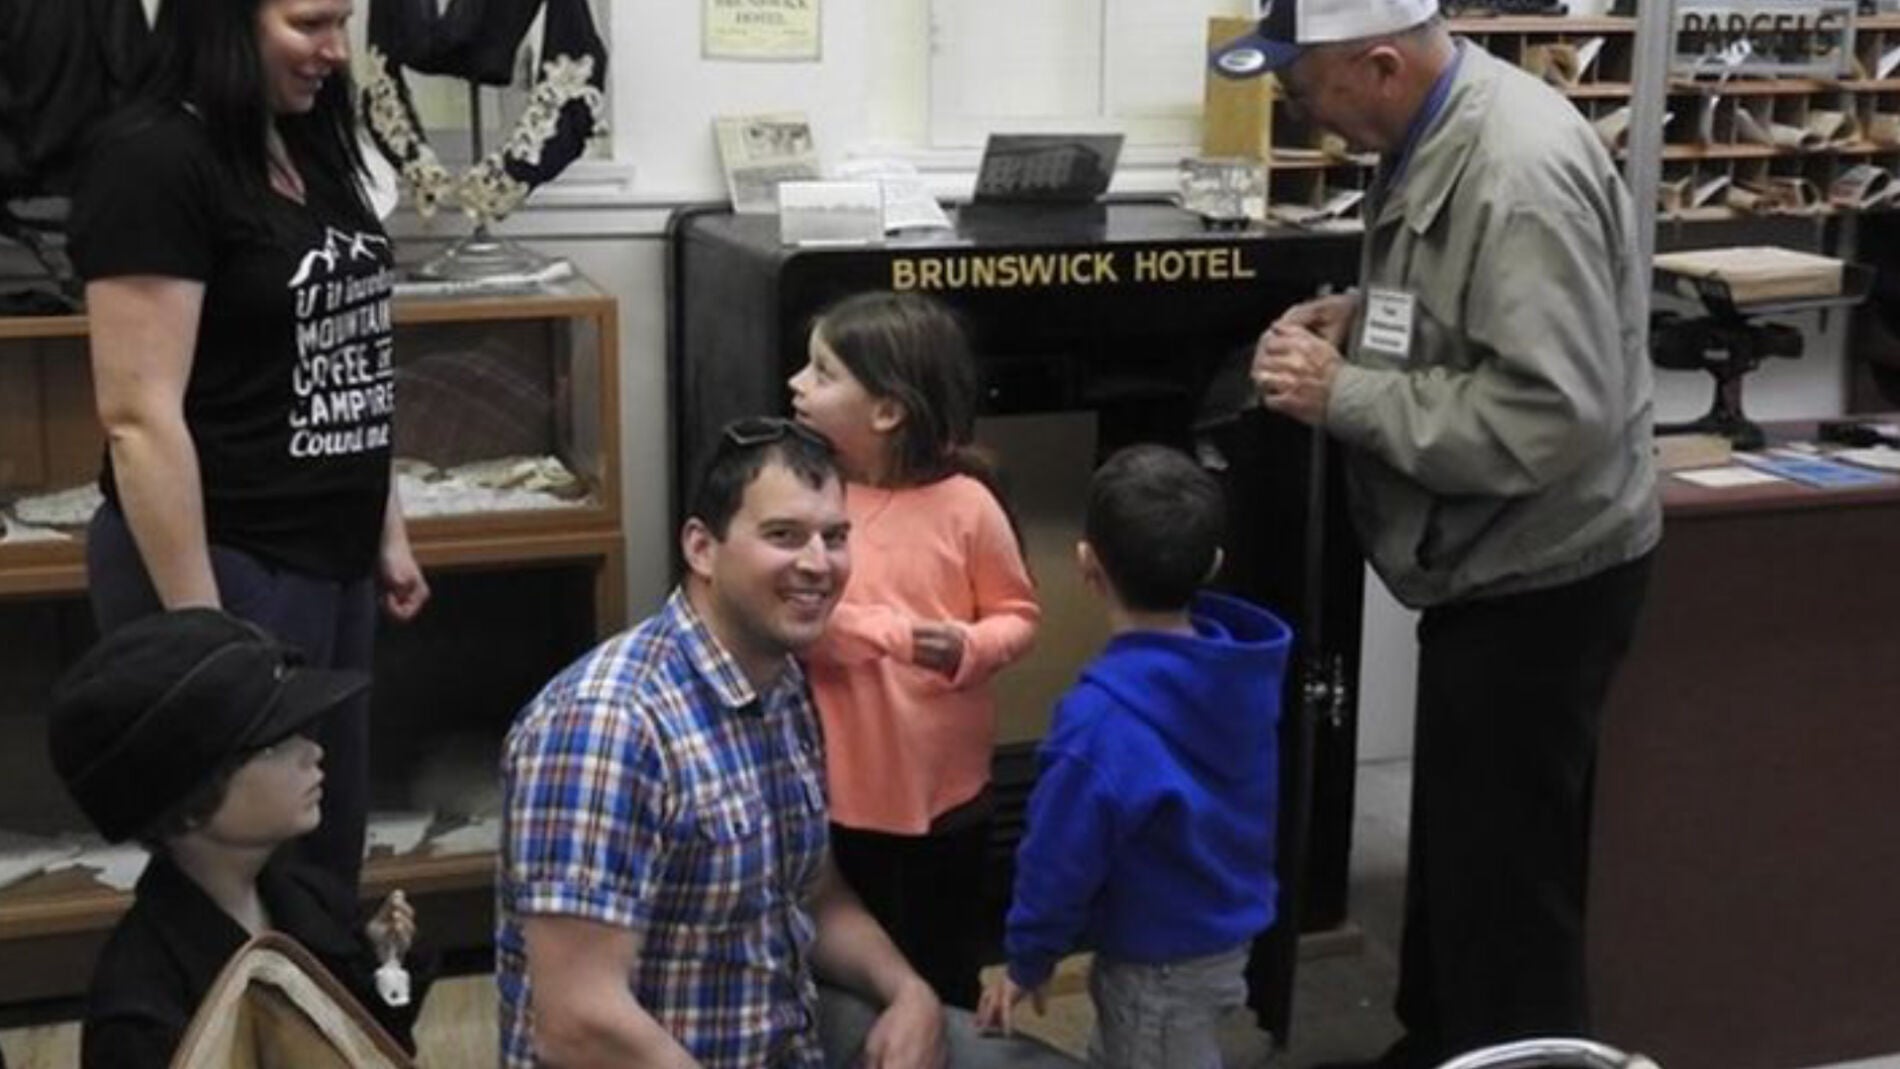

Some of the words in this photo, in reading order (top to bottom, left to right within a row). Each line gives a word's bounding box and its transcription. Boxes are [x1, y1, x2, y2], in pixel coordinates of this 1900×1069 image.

[1683, 13, 1838, 56] PARCELS
[892, 253, 1119, 290] BRUNSWICK
[1134, 247, 1257, 282] HOTEL
